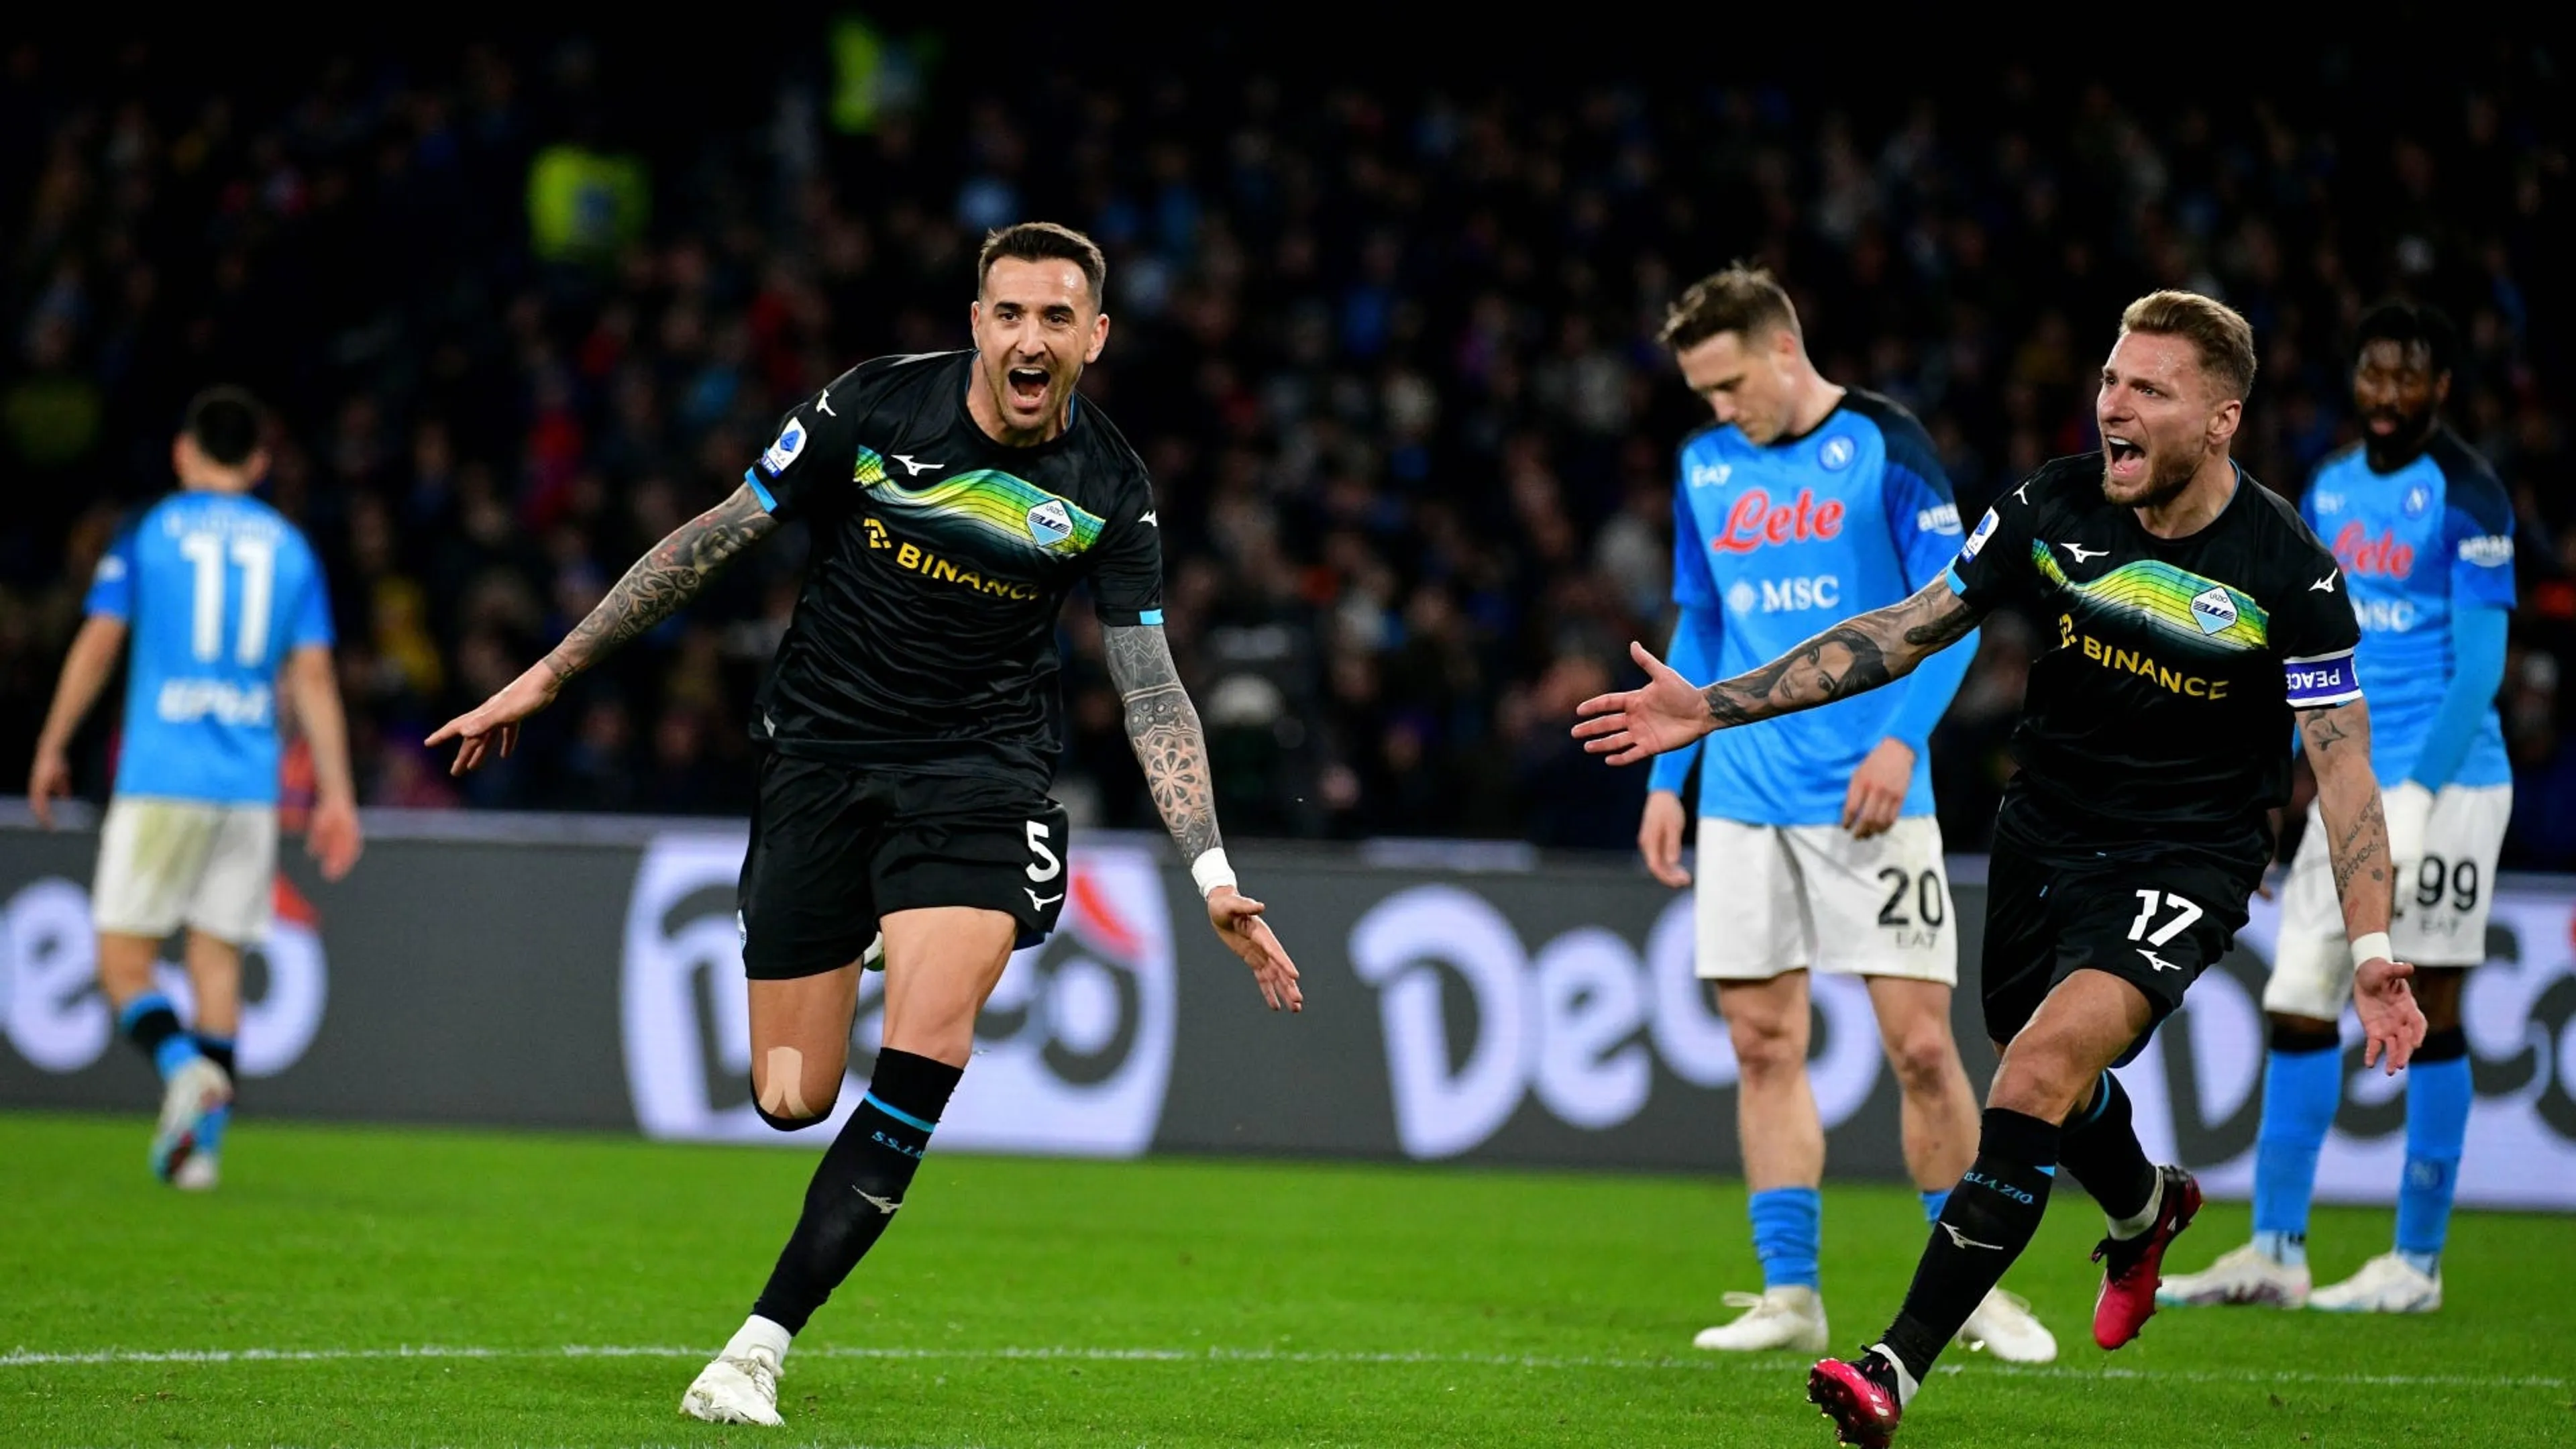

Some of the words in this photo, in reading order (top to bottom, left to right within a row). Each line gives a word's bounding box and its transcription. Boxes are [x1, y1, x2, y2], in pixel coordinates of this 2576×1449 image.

[1711, 488, 1845, 553] Lete
[180, 534, 275, 665] 11
[1762, 575, 1840, 612] MSC
[2084, 635, 2230, 700] BINANCE
[1025, 820, 1061, 883] 5
[1878, 867, 1943, 926] 20
[2416, 855, 2478, 912] 99
[2127, 889, 2203, 947] 17
